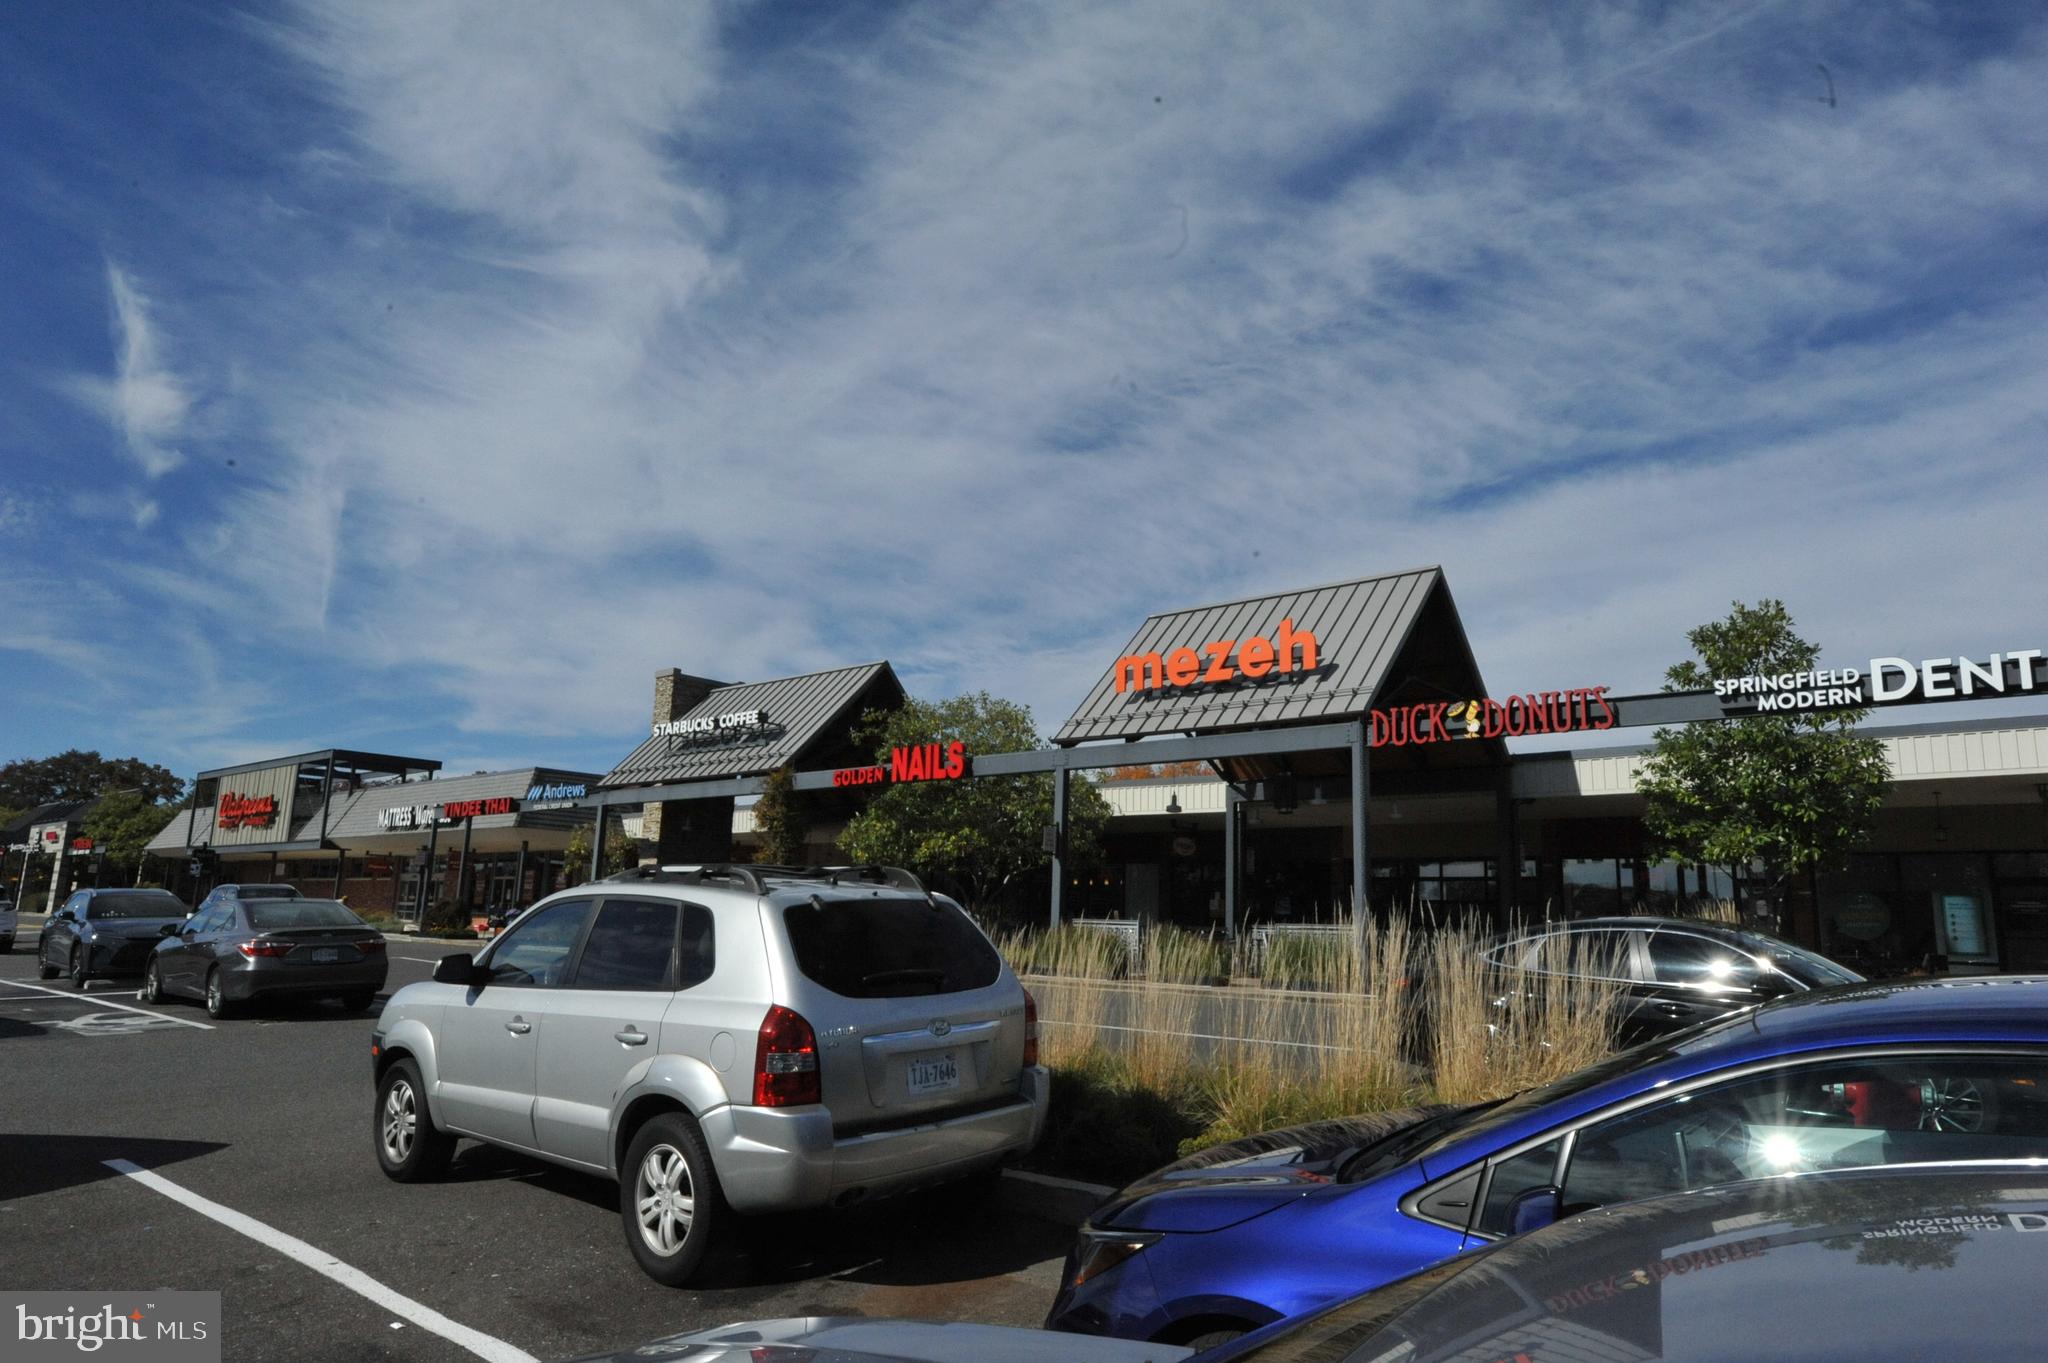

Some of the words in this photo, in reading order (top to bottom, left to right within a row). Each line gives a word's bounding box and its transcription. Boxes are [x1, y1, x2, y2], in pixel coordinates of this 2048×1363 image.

[1115, 617, 1318, 694] mezeh
[1713, 667, 1860, 697] SPRINGFIELD
[1757, 686, 1863, 712] MODERN
[653, 716, 715, 737] STARBUCKS
[719, 709, 760, 729] COFFEE
[1370, 702, 1453, 748] DUCK
[1483, 686, 1615, 738] DONUTS
[832, 766, 884, 788] GOLDEN
[891, 739, 965, 783] NAILS
[543, 783, 585, 799] Andrews
[377, 806, 412, 828] MATTRESS
[443, 799, 482, 817] YINDEE
[485, 797, 512, 815] THAI
